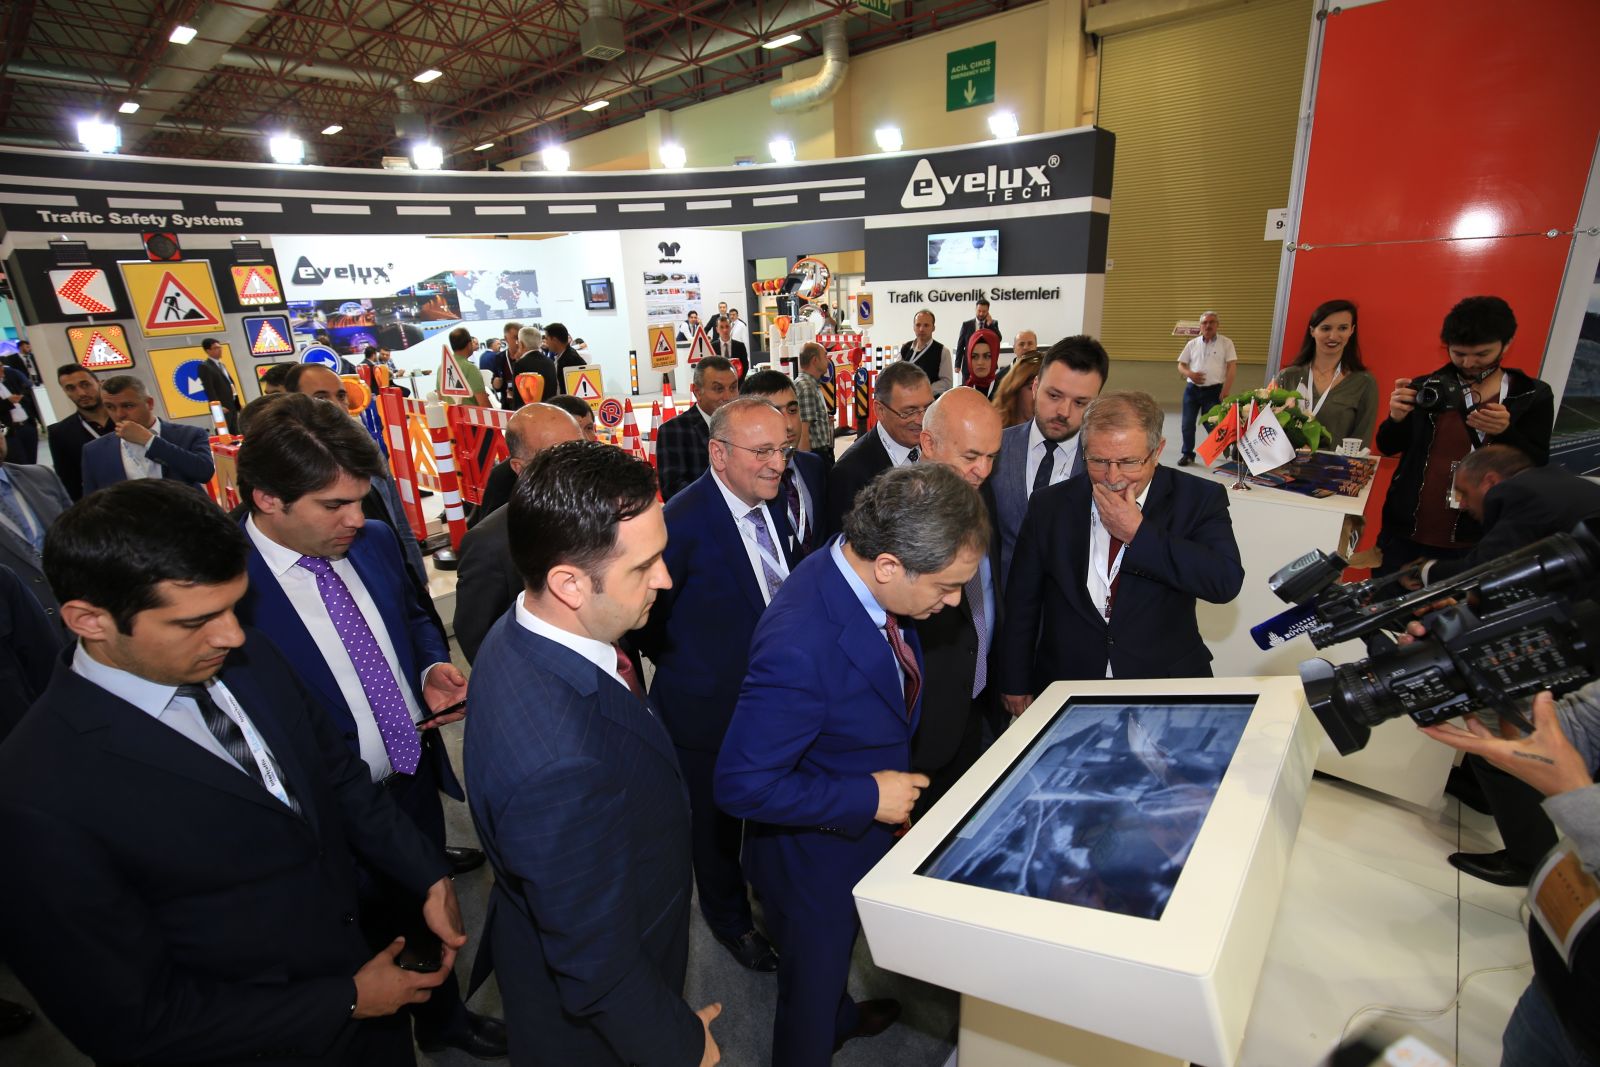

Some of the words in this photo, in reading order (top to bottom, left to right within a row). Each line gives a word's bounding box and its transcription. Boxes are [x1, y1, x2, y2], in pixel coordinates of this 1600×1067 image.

[987, 185, 1051, 203] TECH
[36, 210, 105, 224] Traffic
[108, 212, 167, 228] Safety
[171, 213, 244, 229] Systems
[888, 290, 924, 303] Trafik
[927, 288, 986, 302] Güvenlik
[990, 286, 1060, 301] Sistemleri
